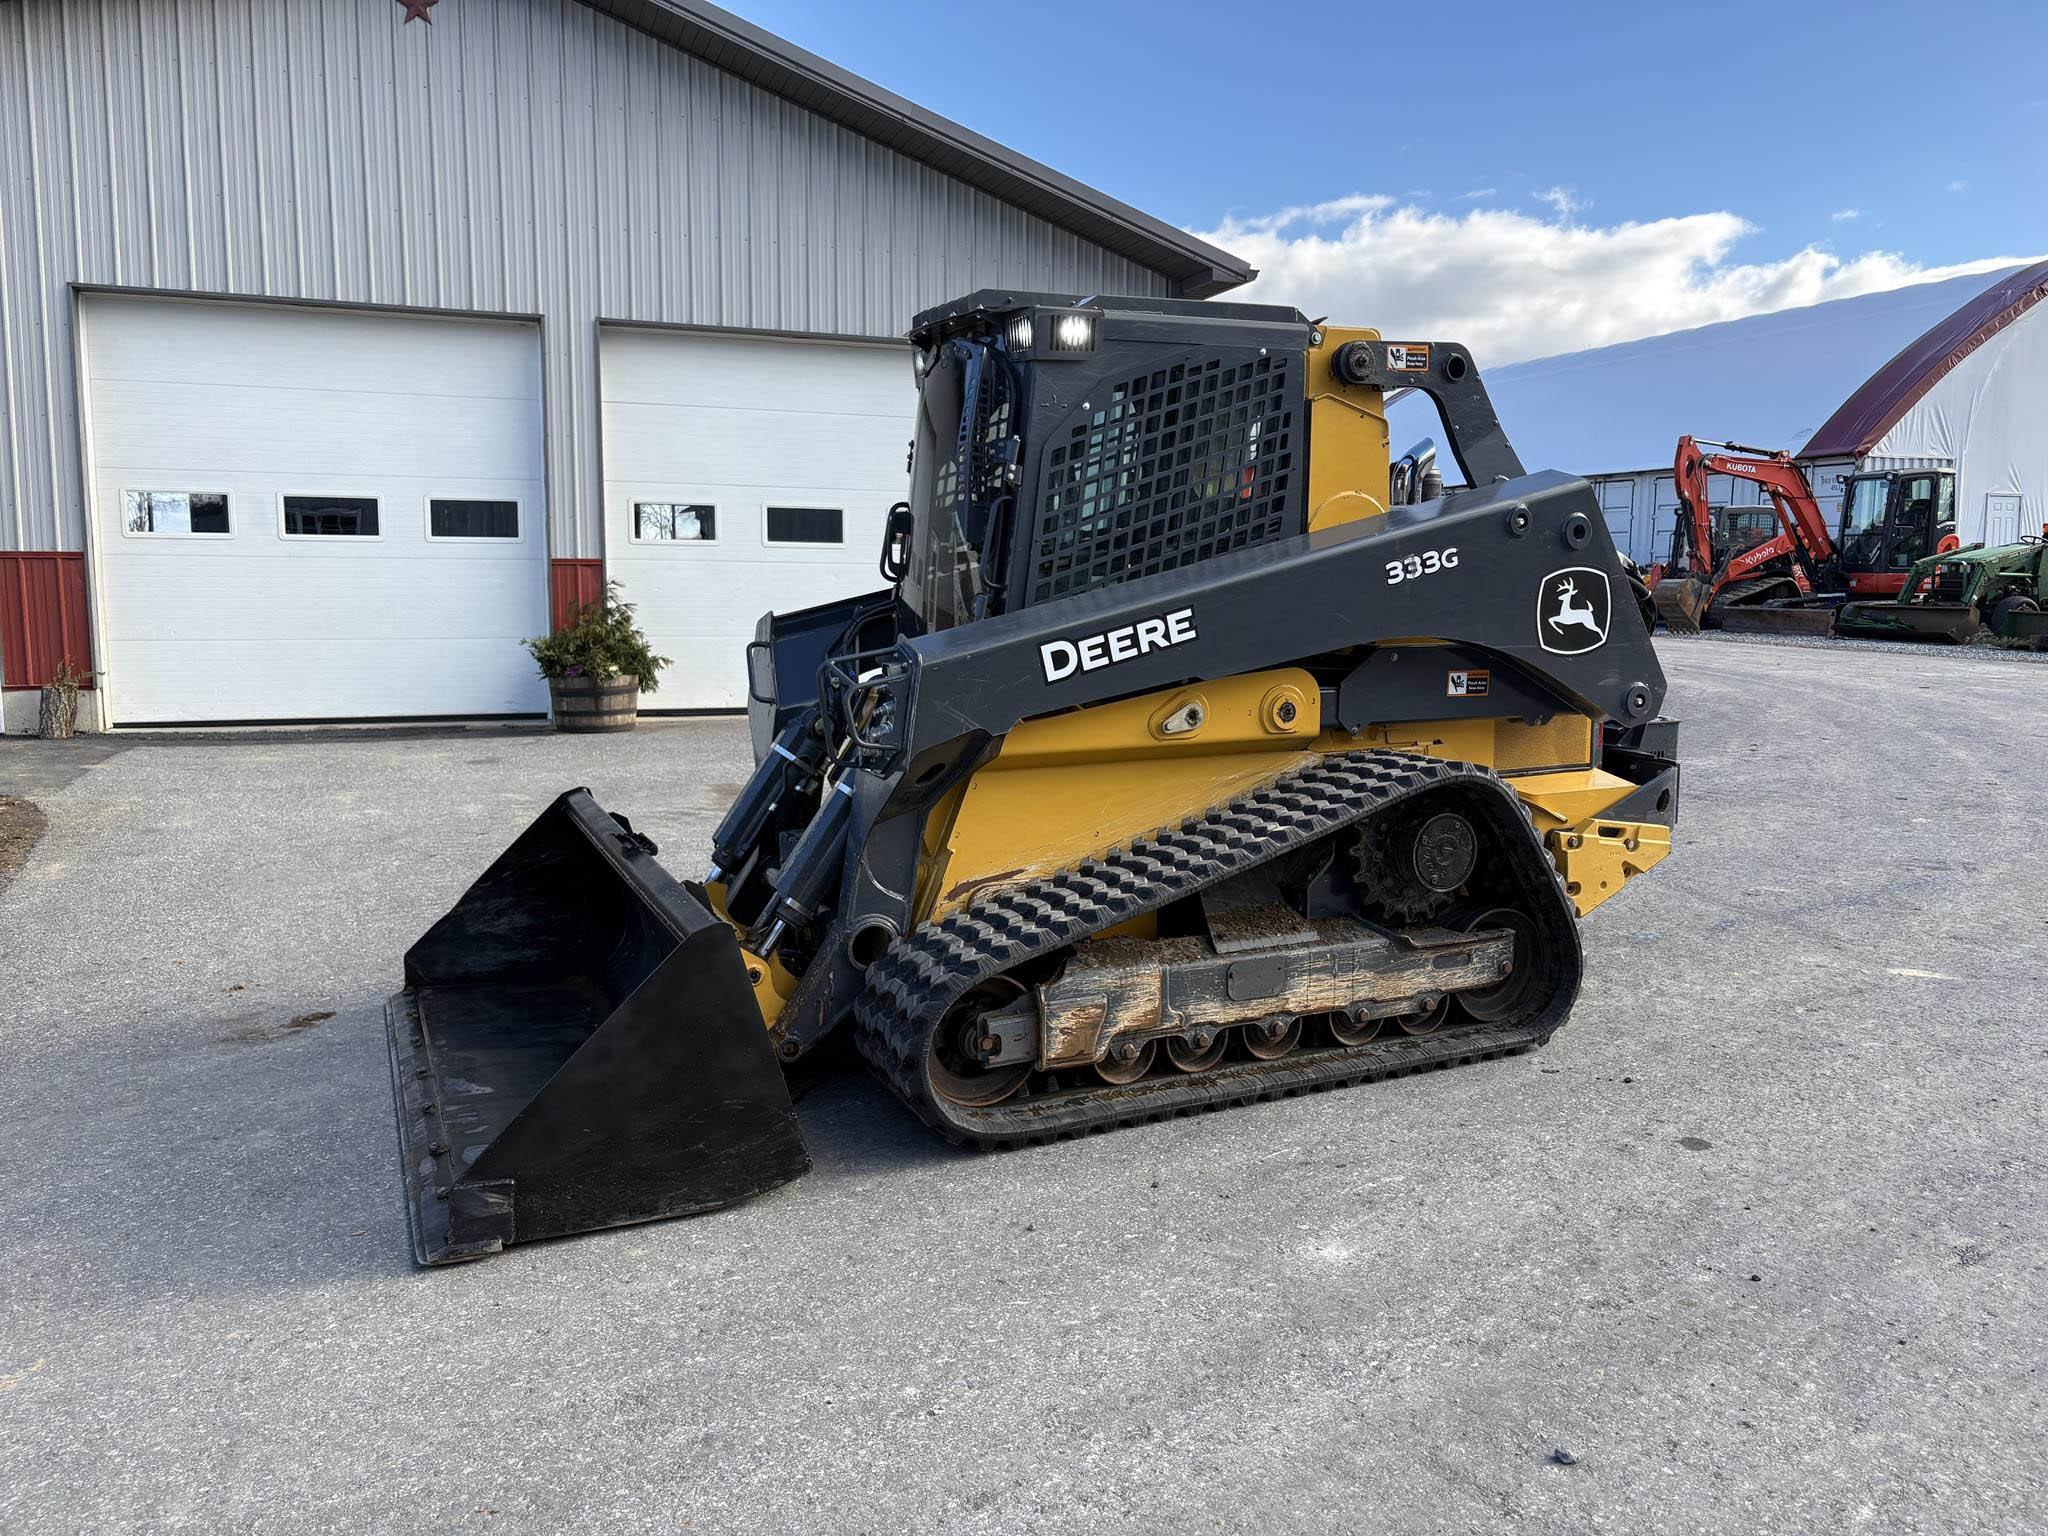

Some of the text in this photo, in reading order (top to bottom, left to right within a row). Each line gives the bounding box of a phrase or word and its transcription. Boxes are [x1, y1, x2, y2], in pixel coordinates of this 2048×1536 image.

[1726, 462, 1757, 473] KUBOTA
[1385, 547, 1459, 585] 333G
[1745, 547, 1775, 565] Kubota
[1040, 608, 1197, 683] DEERE
